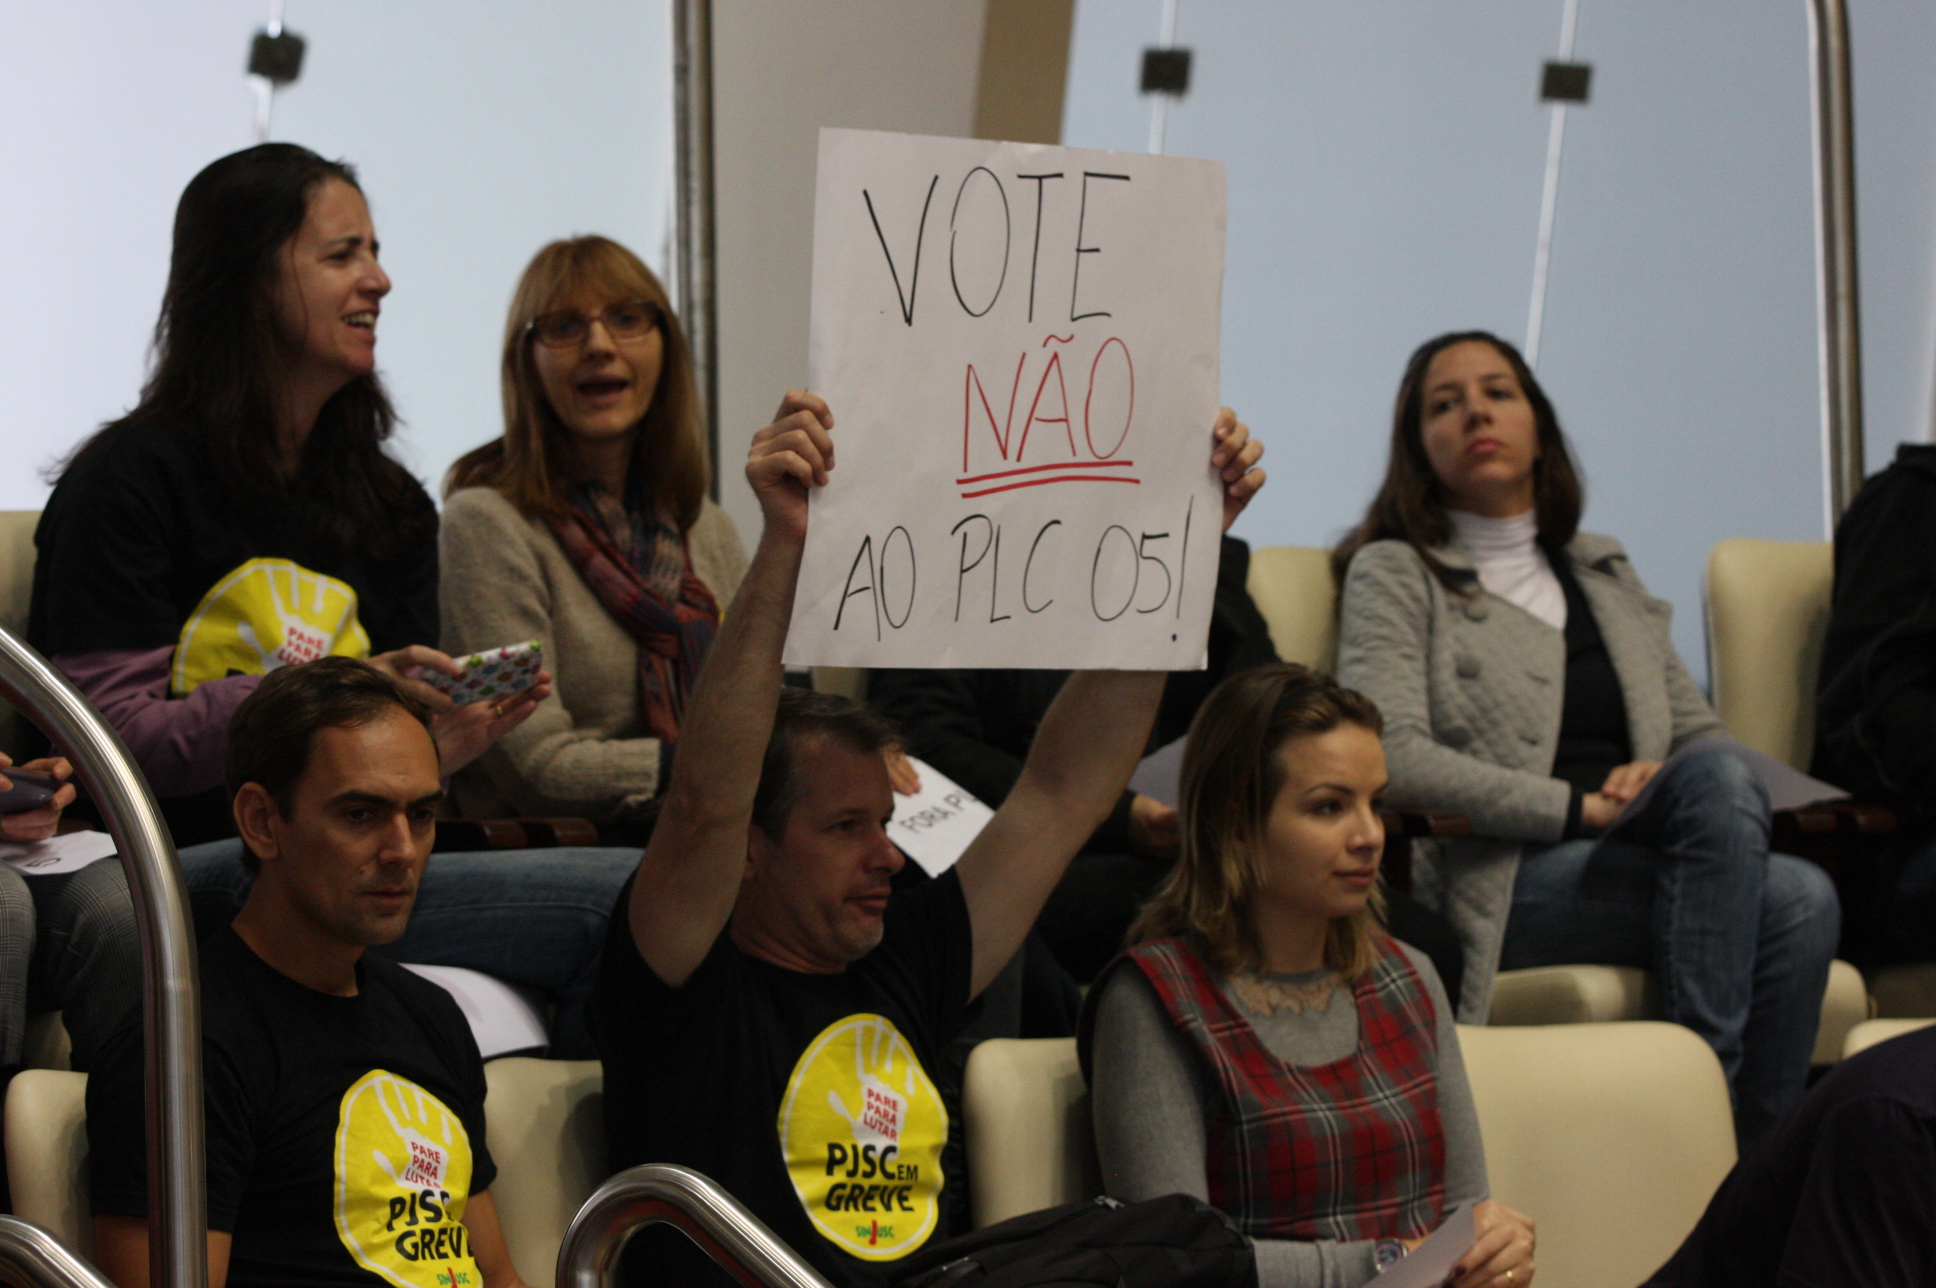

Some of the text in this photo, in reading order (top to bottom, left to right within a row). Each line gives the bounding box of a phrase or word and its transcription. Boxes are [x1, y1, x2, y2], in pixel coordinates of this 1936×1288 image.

[863, 166, 1131, 326] VOTE
[963, 334, 1134, 473] NÃO
[833, 525, 916, 642] AO
[951, 513, 1062, 623] PLC
[288, 627, 324, 650] PARE
[867, 1087, 898, 1112] PARE
[867, 1101, 898, 1126] PARA
[863, 1112, 898, 1142] LUTAR
[411, 1141, 441, 1164] PARE
[412, 1154, 438, 1180] PARA
[826, 1142, 918, 1181] PJSC EM
[825, 1182, 915, 1212] GREVE
